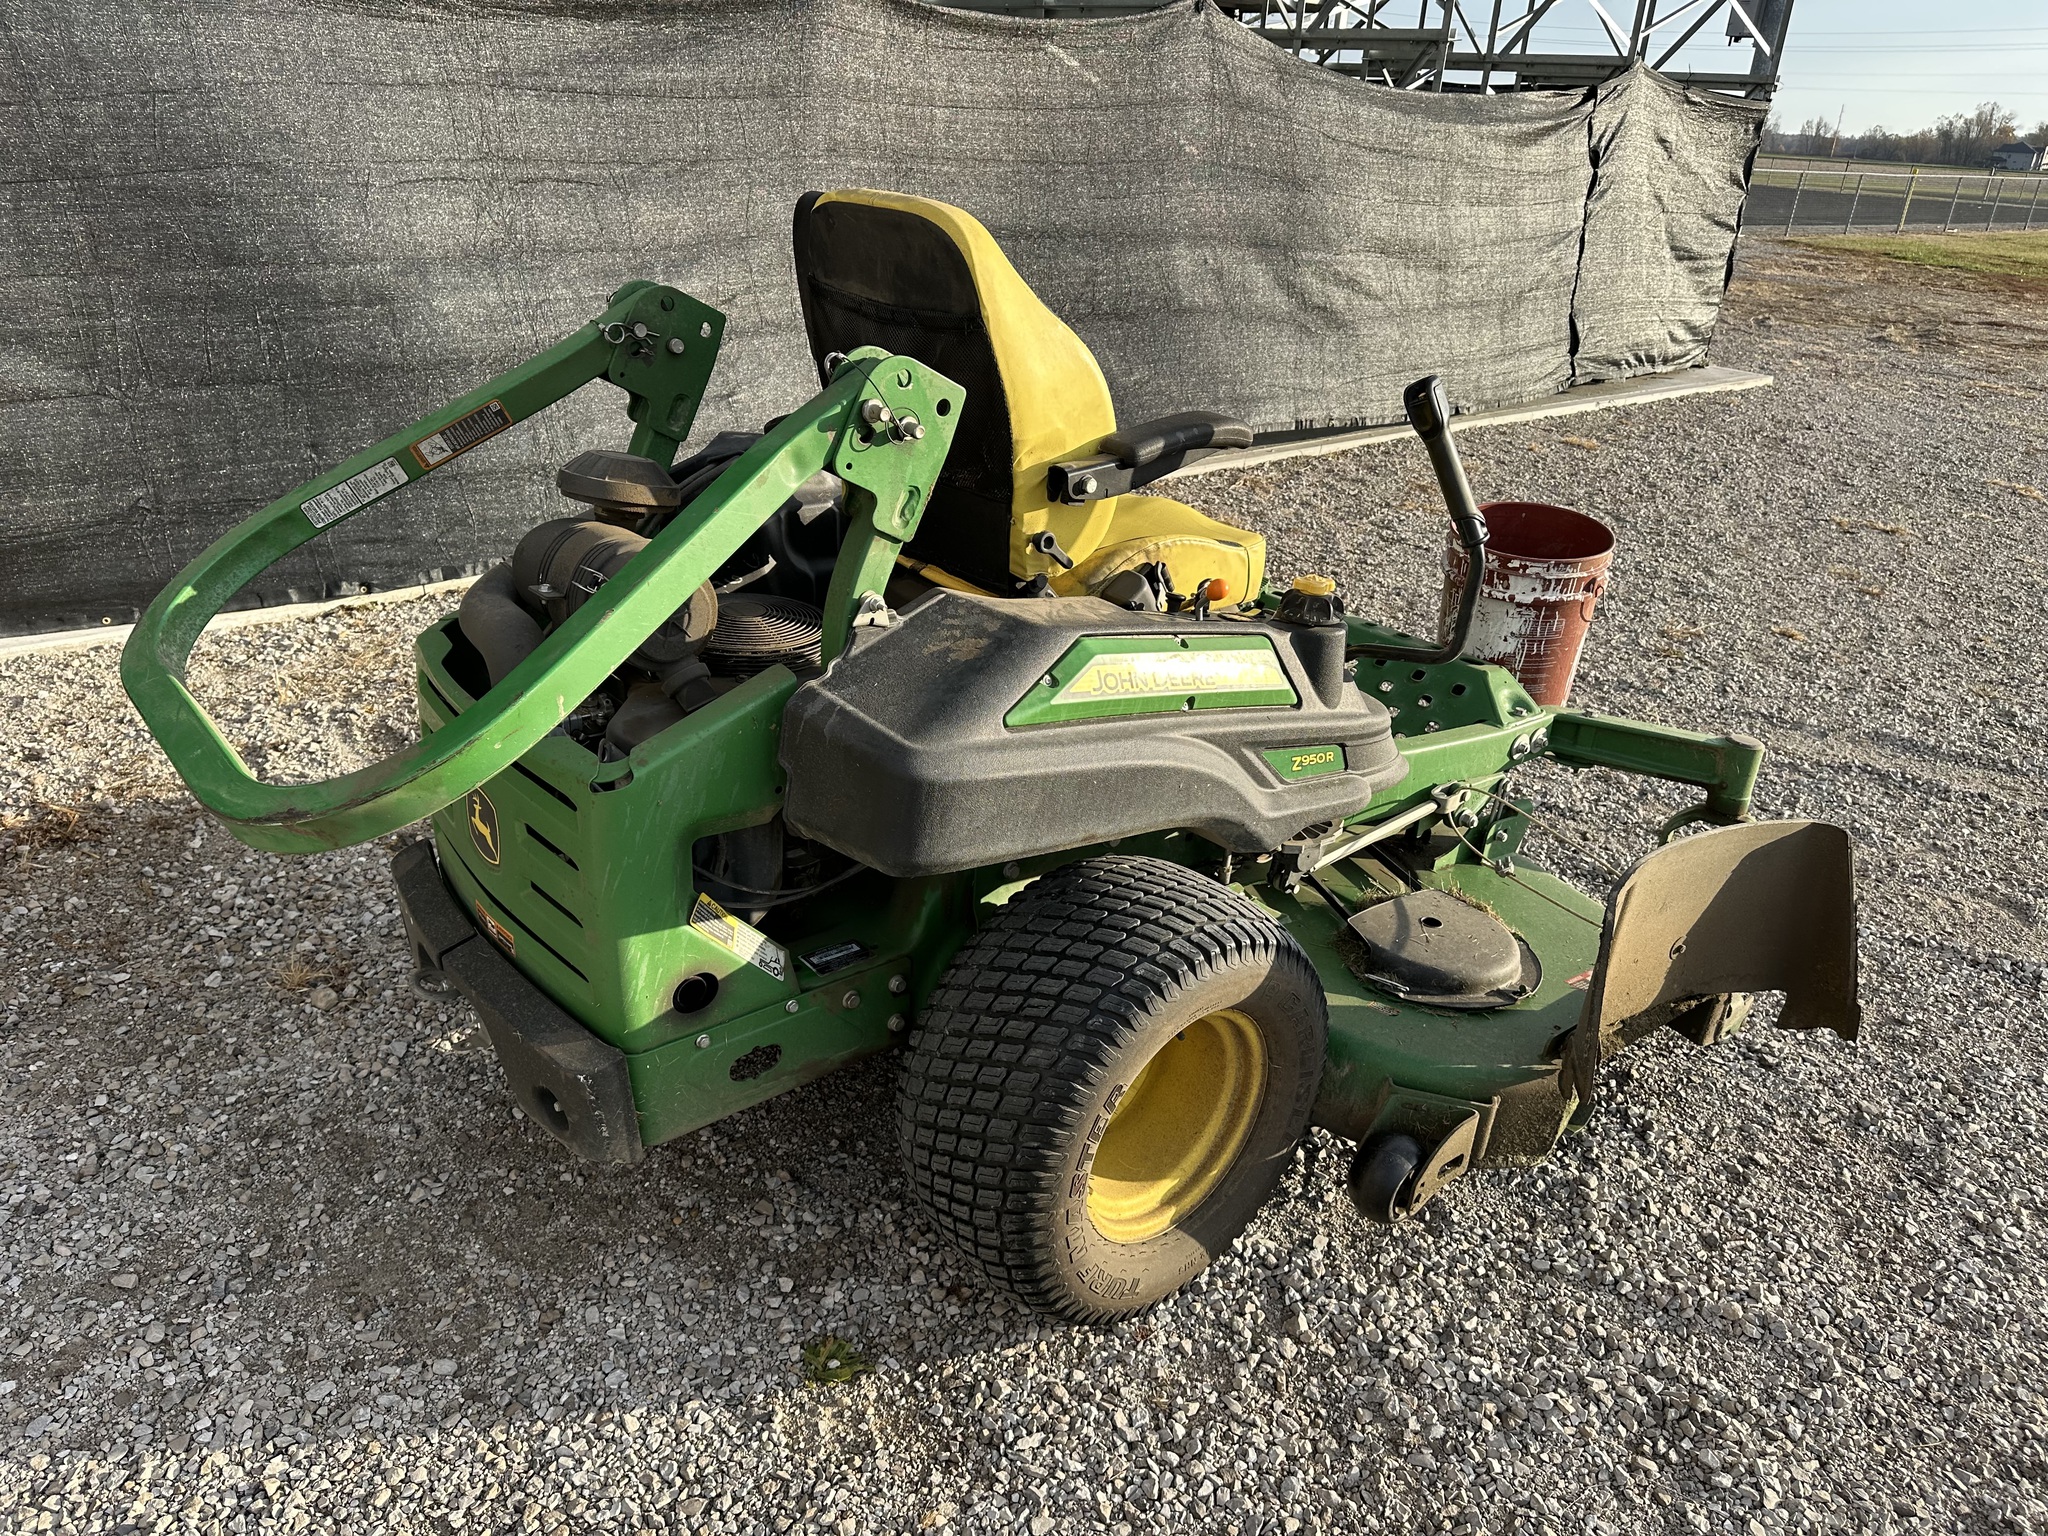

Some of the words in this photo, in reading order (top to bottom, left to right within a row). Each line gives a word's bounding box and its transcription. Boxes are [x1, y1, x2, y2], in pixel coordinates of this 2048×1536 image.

[1092, 669, 1148, 692] JOHN
[1152, 671, 1216, 688] DEERE
[1292, 752, 1334, 771] Z950R
[1066, 1083, 1128, 1264] MASTER
[1076, 1262, 1140, 1299] TURF
